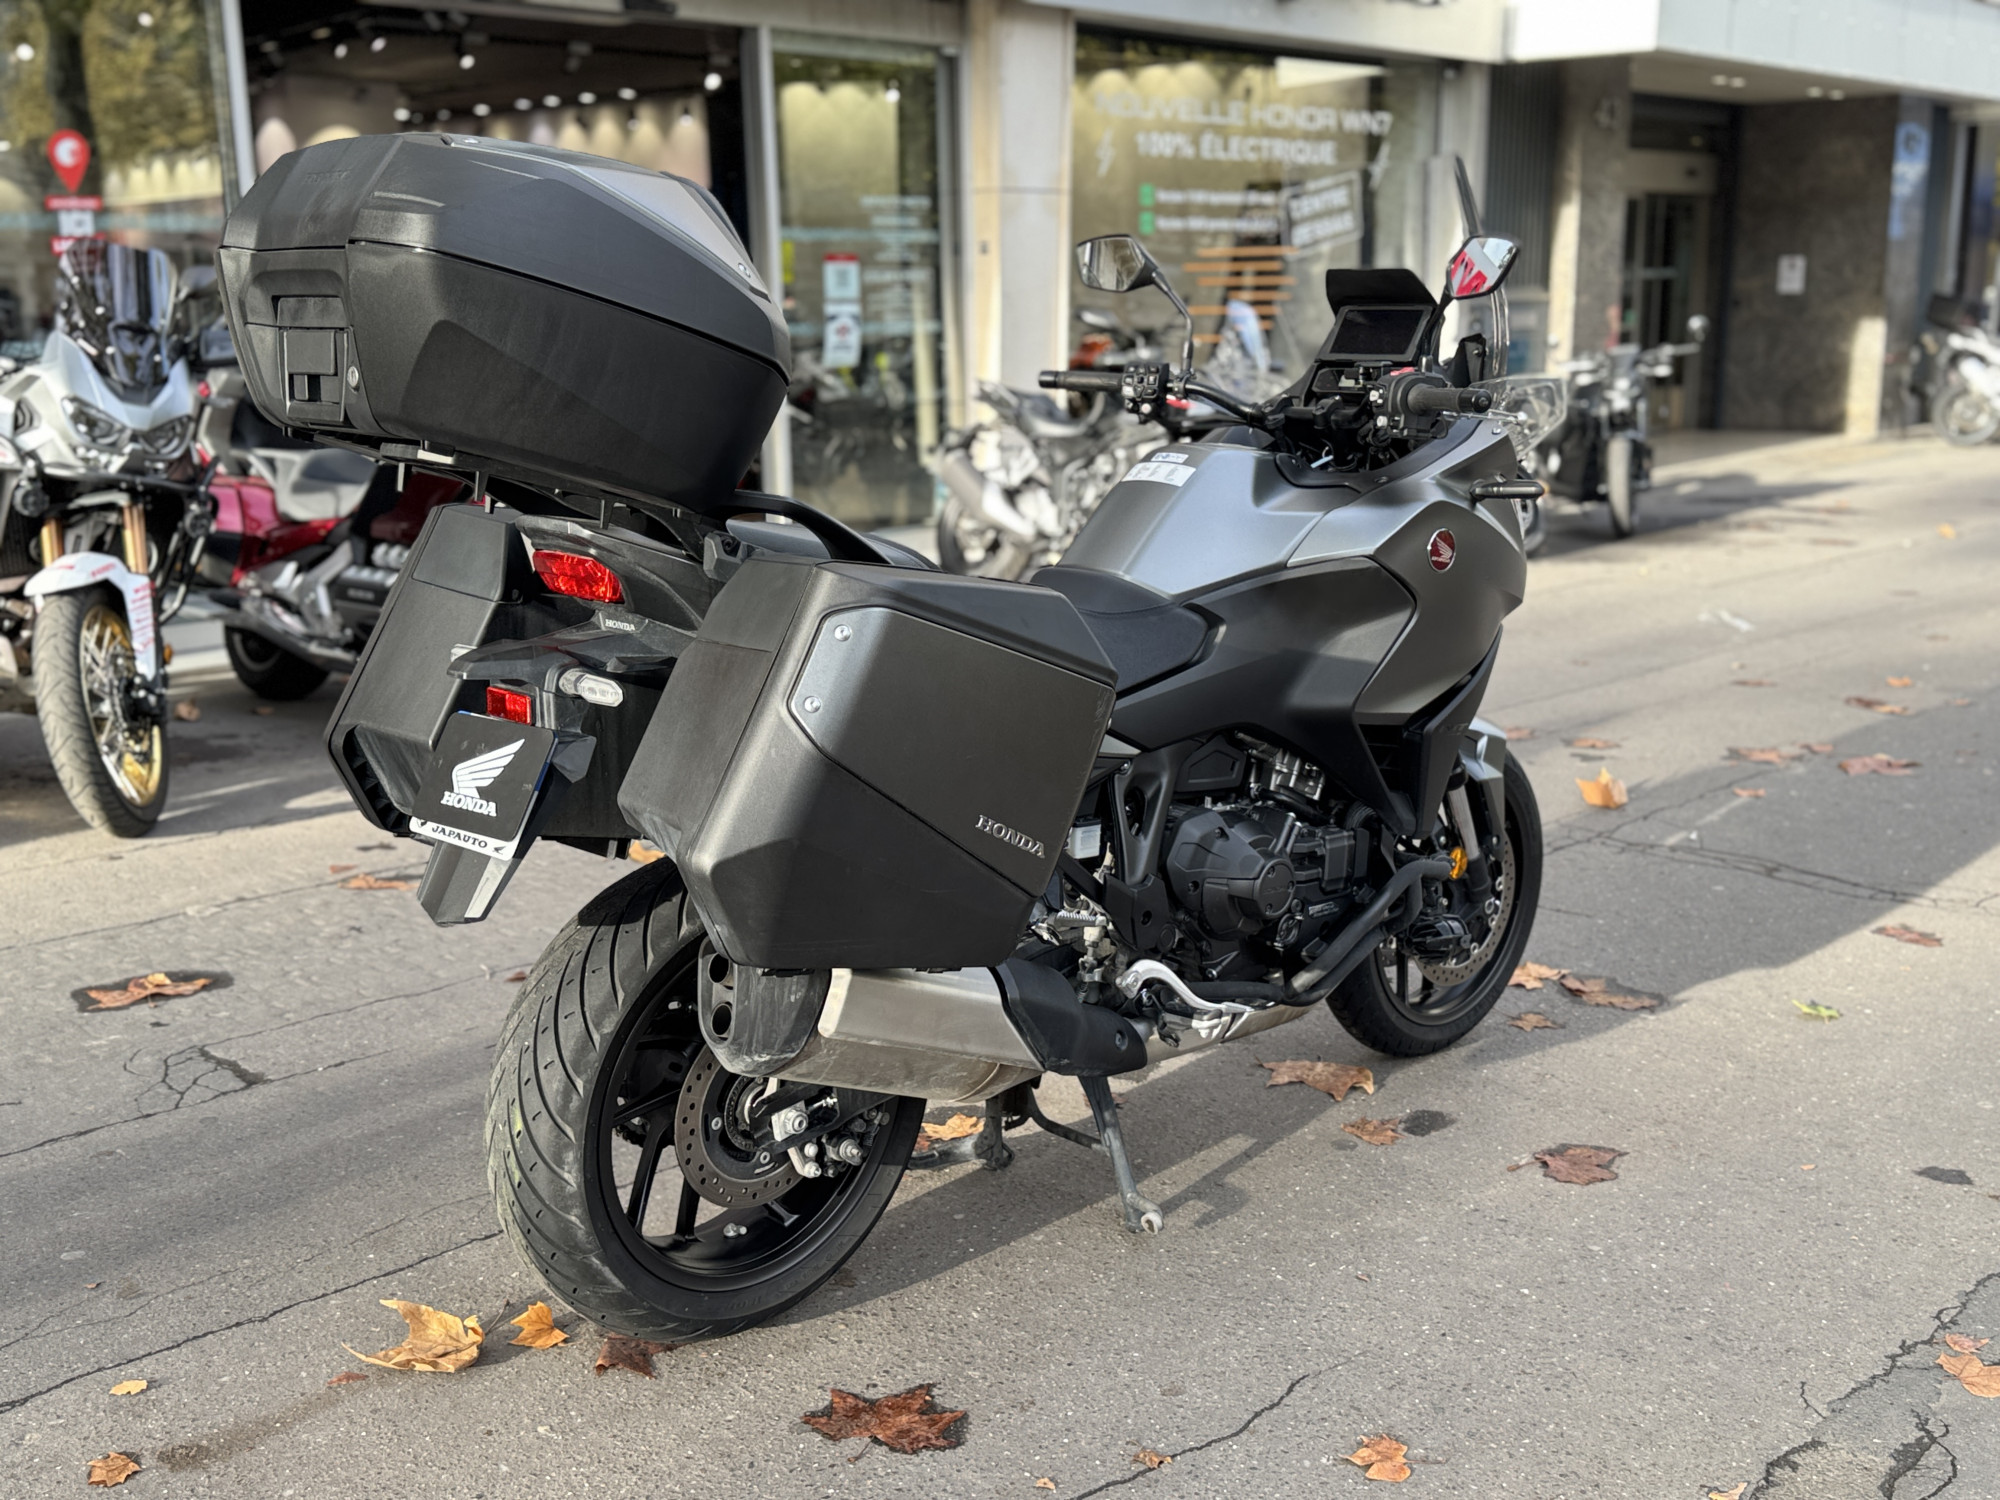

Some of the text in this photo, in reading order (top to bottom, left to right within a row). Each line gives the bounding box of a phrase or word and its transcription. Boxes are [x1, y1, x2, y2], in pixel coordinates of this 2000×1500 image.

[1095, 91, 1245, 126] NOUVELLE
[1136, 128, 1338, 165] 100% ÉLECTRIQUE
[605, 618, 636, 632] HONDA
[440, 790, 497, 817] HONDA
[431, 824, 488, 849] JAPAUTO
[975, 814, 1046, 859] HONDA
